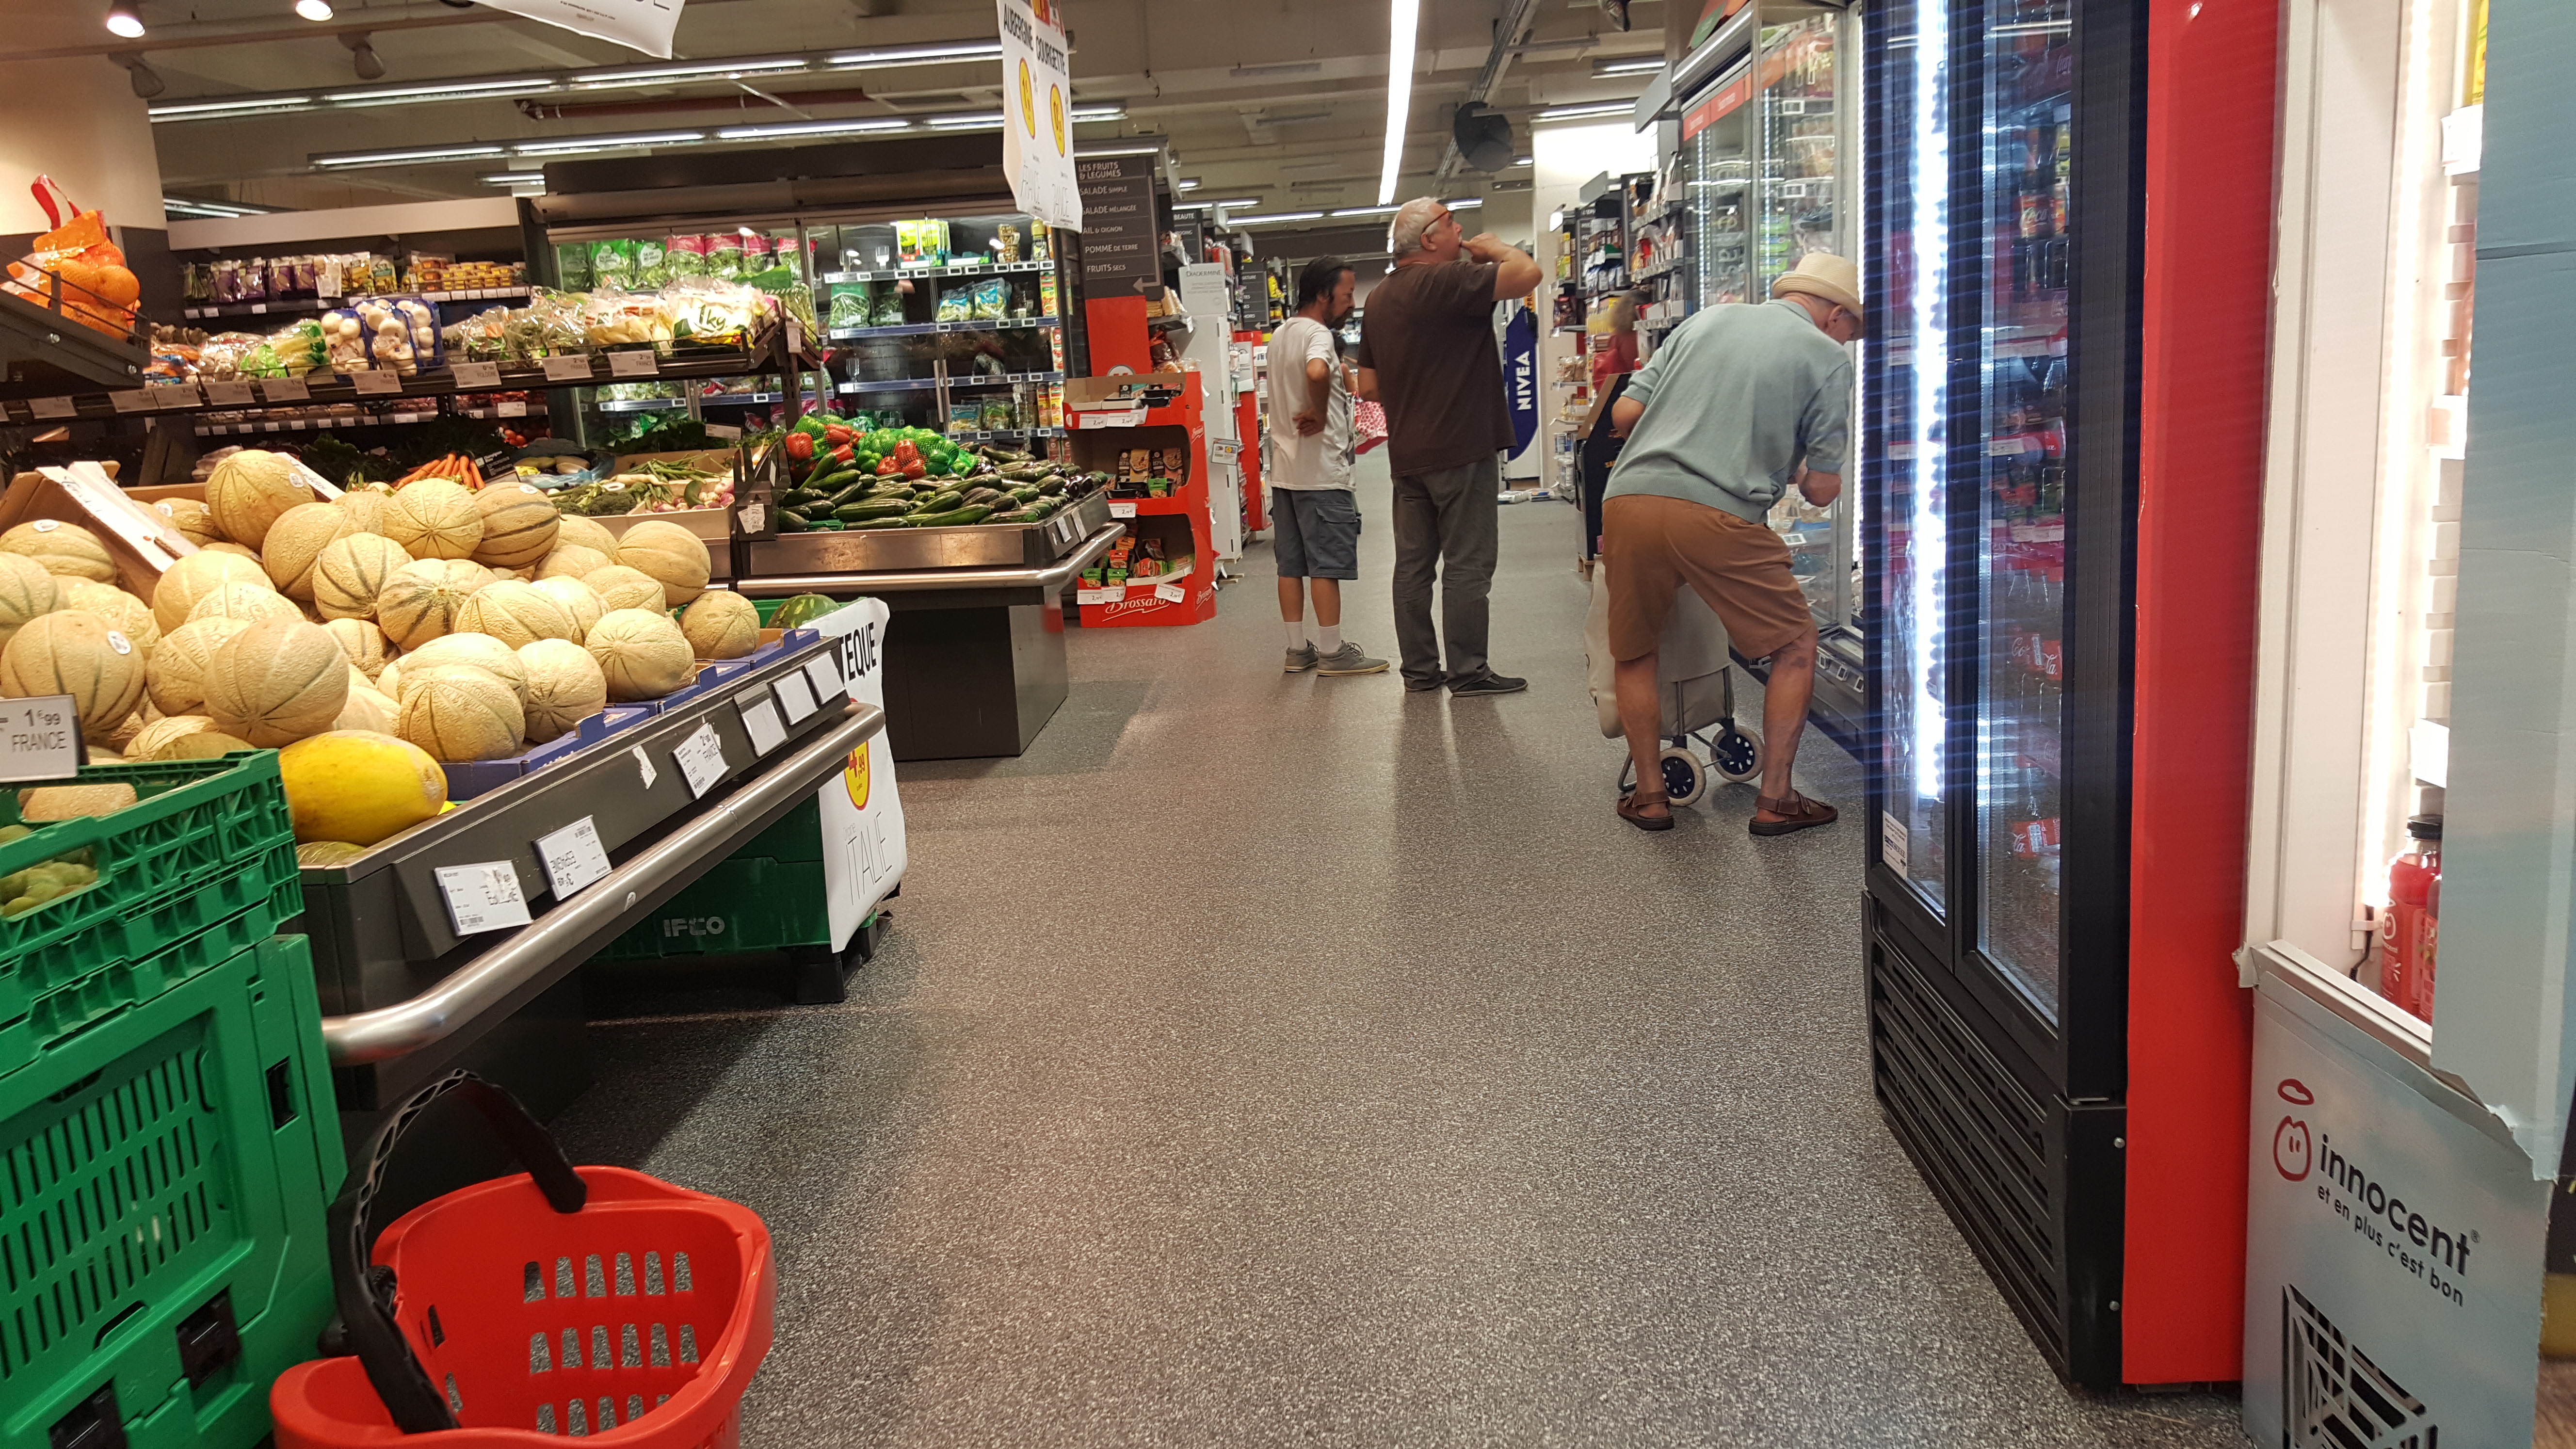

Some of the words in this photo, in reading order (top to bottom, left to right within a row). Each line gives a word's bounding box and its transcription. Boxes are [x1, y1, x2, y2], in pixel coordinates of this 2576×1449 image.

[1004, 3, 1033, 52] AUBERGINE
[1036, 35, 1066, 76] COURGETTE
[1079, 163, 1092, 172] LES
[1093, 161, 1119, 171] FRUITS
[1079, 186, 1108, 195] SALADE
[1085, 244, 1112, 253] POMME
[1087, 264, 1112, 273] FRUITS
[1514, 350, 1532, 410] NIVEA
[12, 731, 67, 752] FRANCE
[846, 811, 892, 905] ITALIE
[663, 916, 725, 937] IFCO
[2319, 1134, 2471, 1276] innocent
[2318, 1185, 2331, 1205] et
[2334, 1196, 2351, 1221] en
[2354, 1212, 2383, 1247] plus
[2388, 1242, 2424, 1279] c'est
[2430, 1266, 2463, 1307] bon
